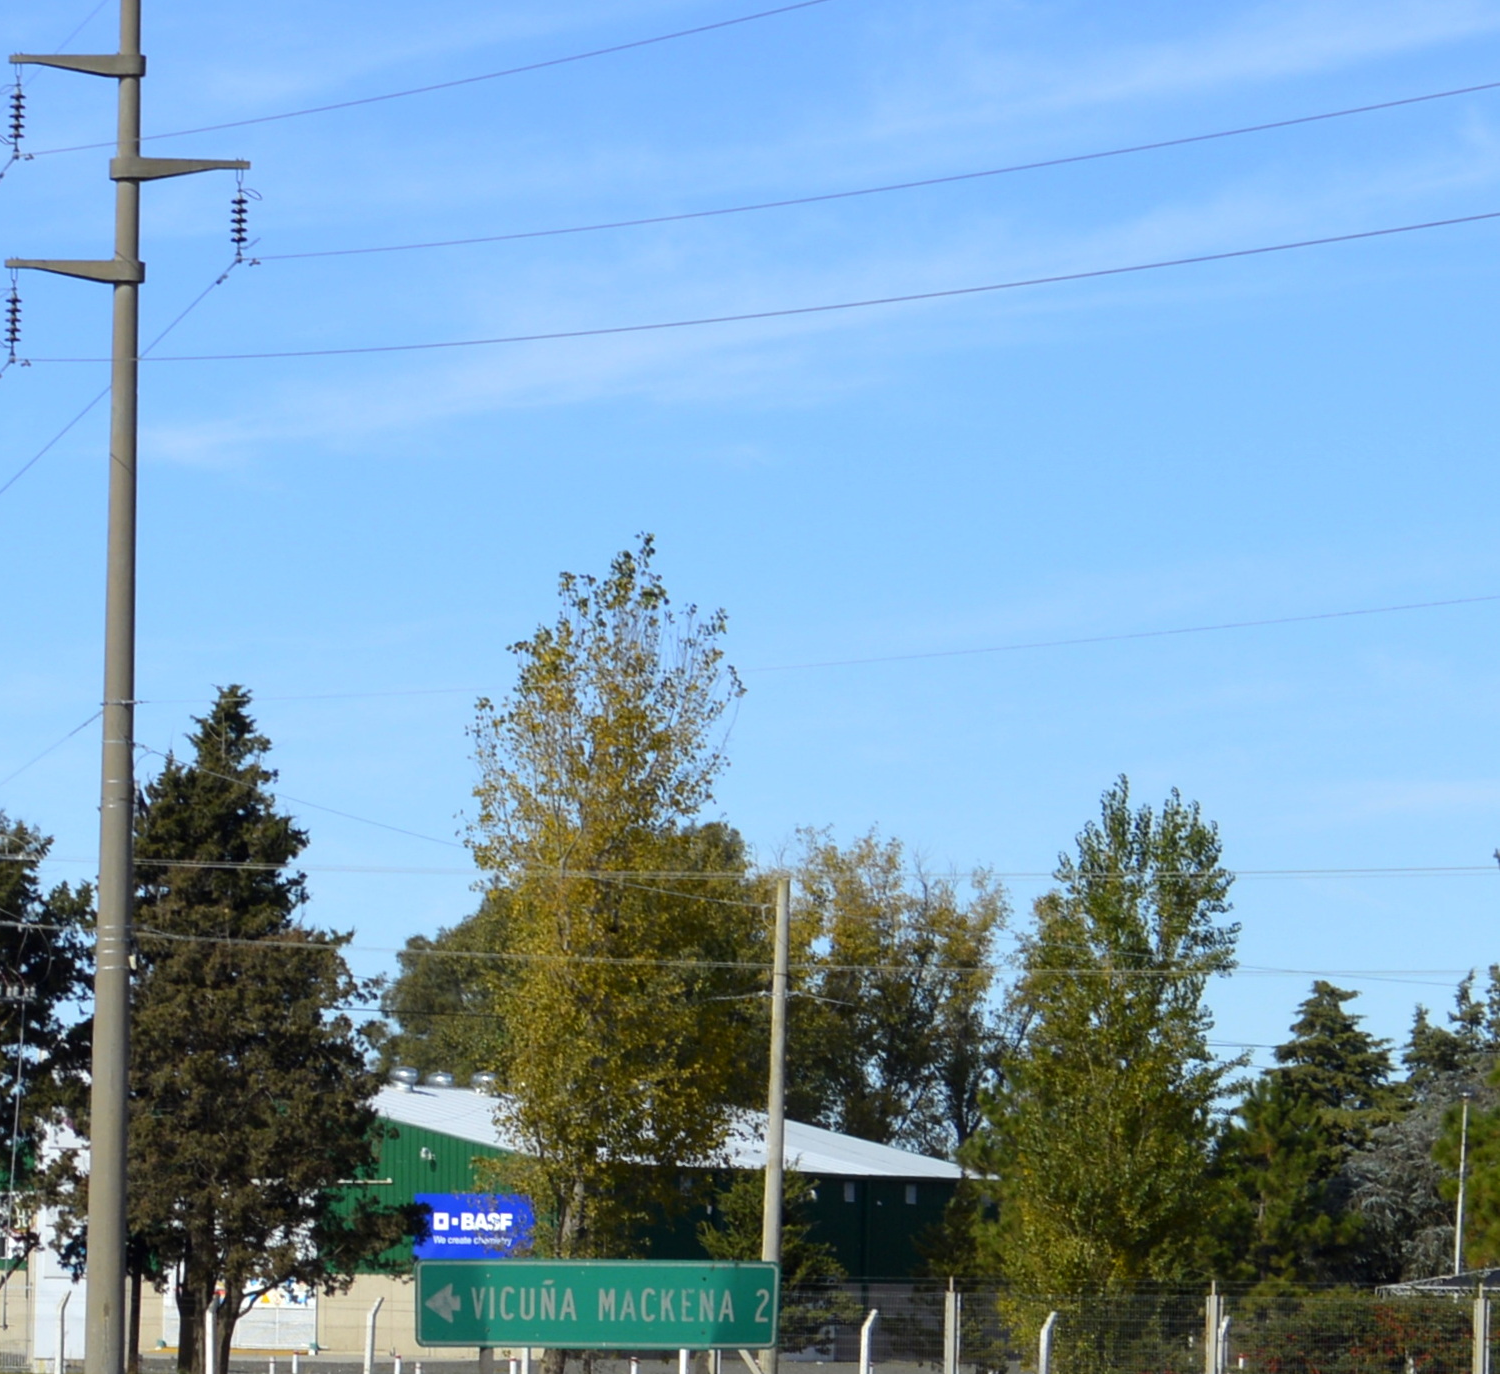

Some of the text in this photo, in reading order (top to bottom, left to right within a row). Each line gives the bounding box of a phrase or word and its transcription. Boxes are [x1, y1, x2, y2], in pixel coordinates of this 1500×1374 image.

[460, 1212, 513, 1231] BASF
[432, 1235, 446, 1245] We
[447, 1236, 472, 1245] create
[470, 1280, 770, 1323] VICUÑA MACKENA 2
